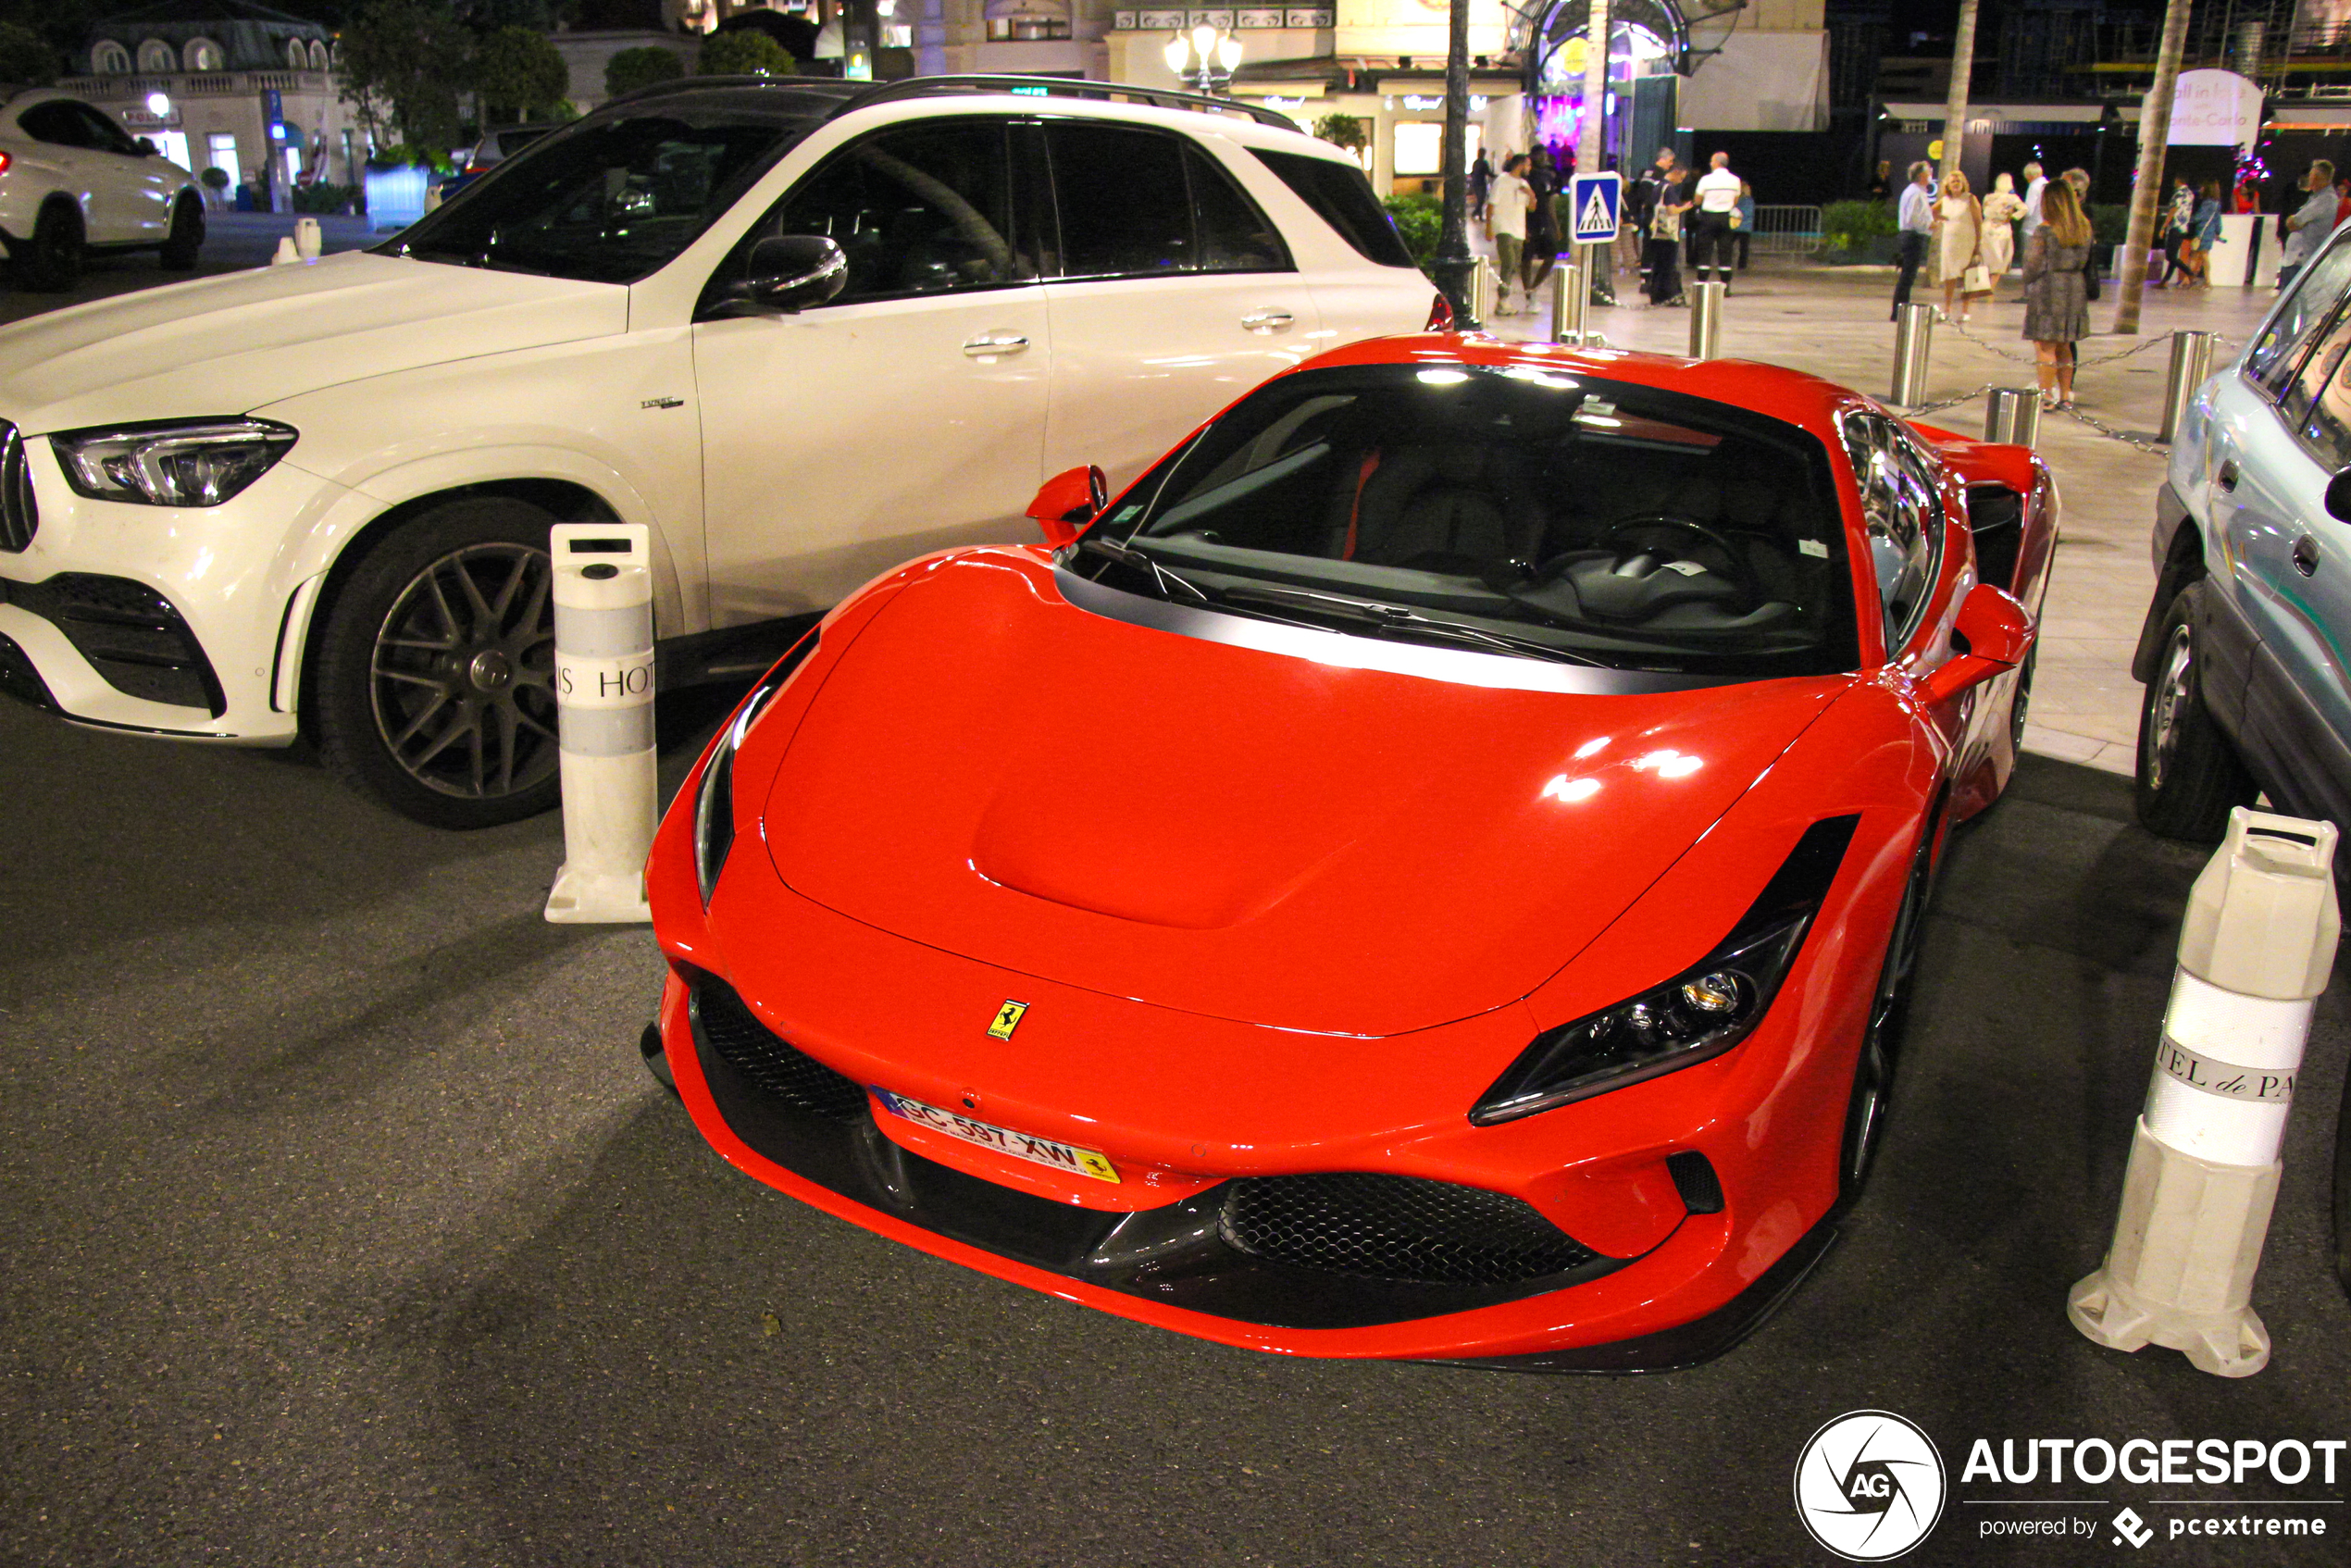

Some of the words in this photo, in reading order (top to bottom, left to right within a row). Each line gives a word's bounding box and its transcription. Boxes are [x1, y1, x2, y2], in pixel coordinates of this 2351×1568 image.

[2174, 82, 2192, 99] all
[2214, 82, 2246, 99] loe
[2170, 112, 2247, 126] onte-Carlo
[556, 665, 573, 694] IS
[2215, 1075, 2247, 1094] de
[897, 1098, 1076, 1166] GC-597-XW
